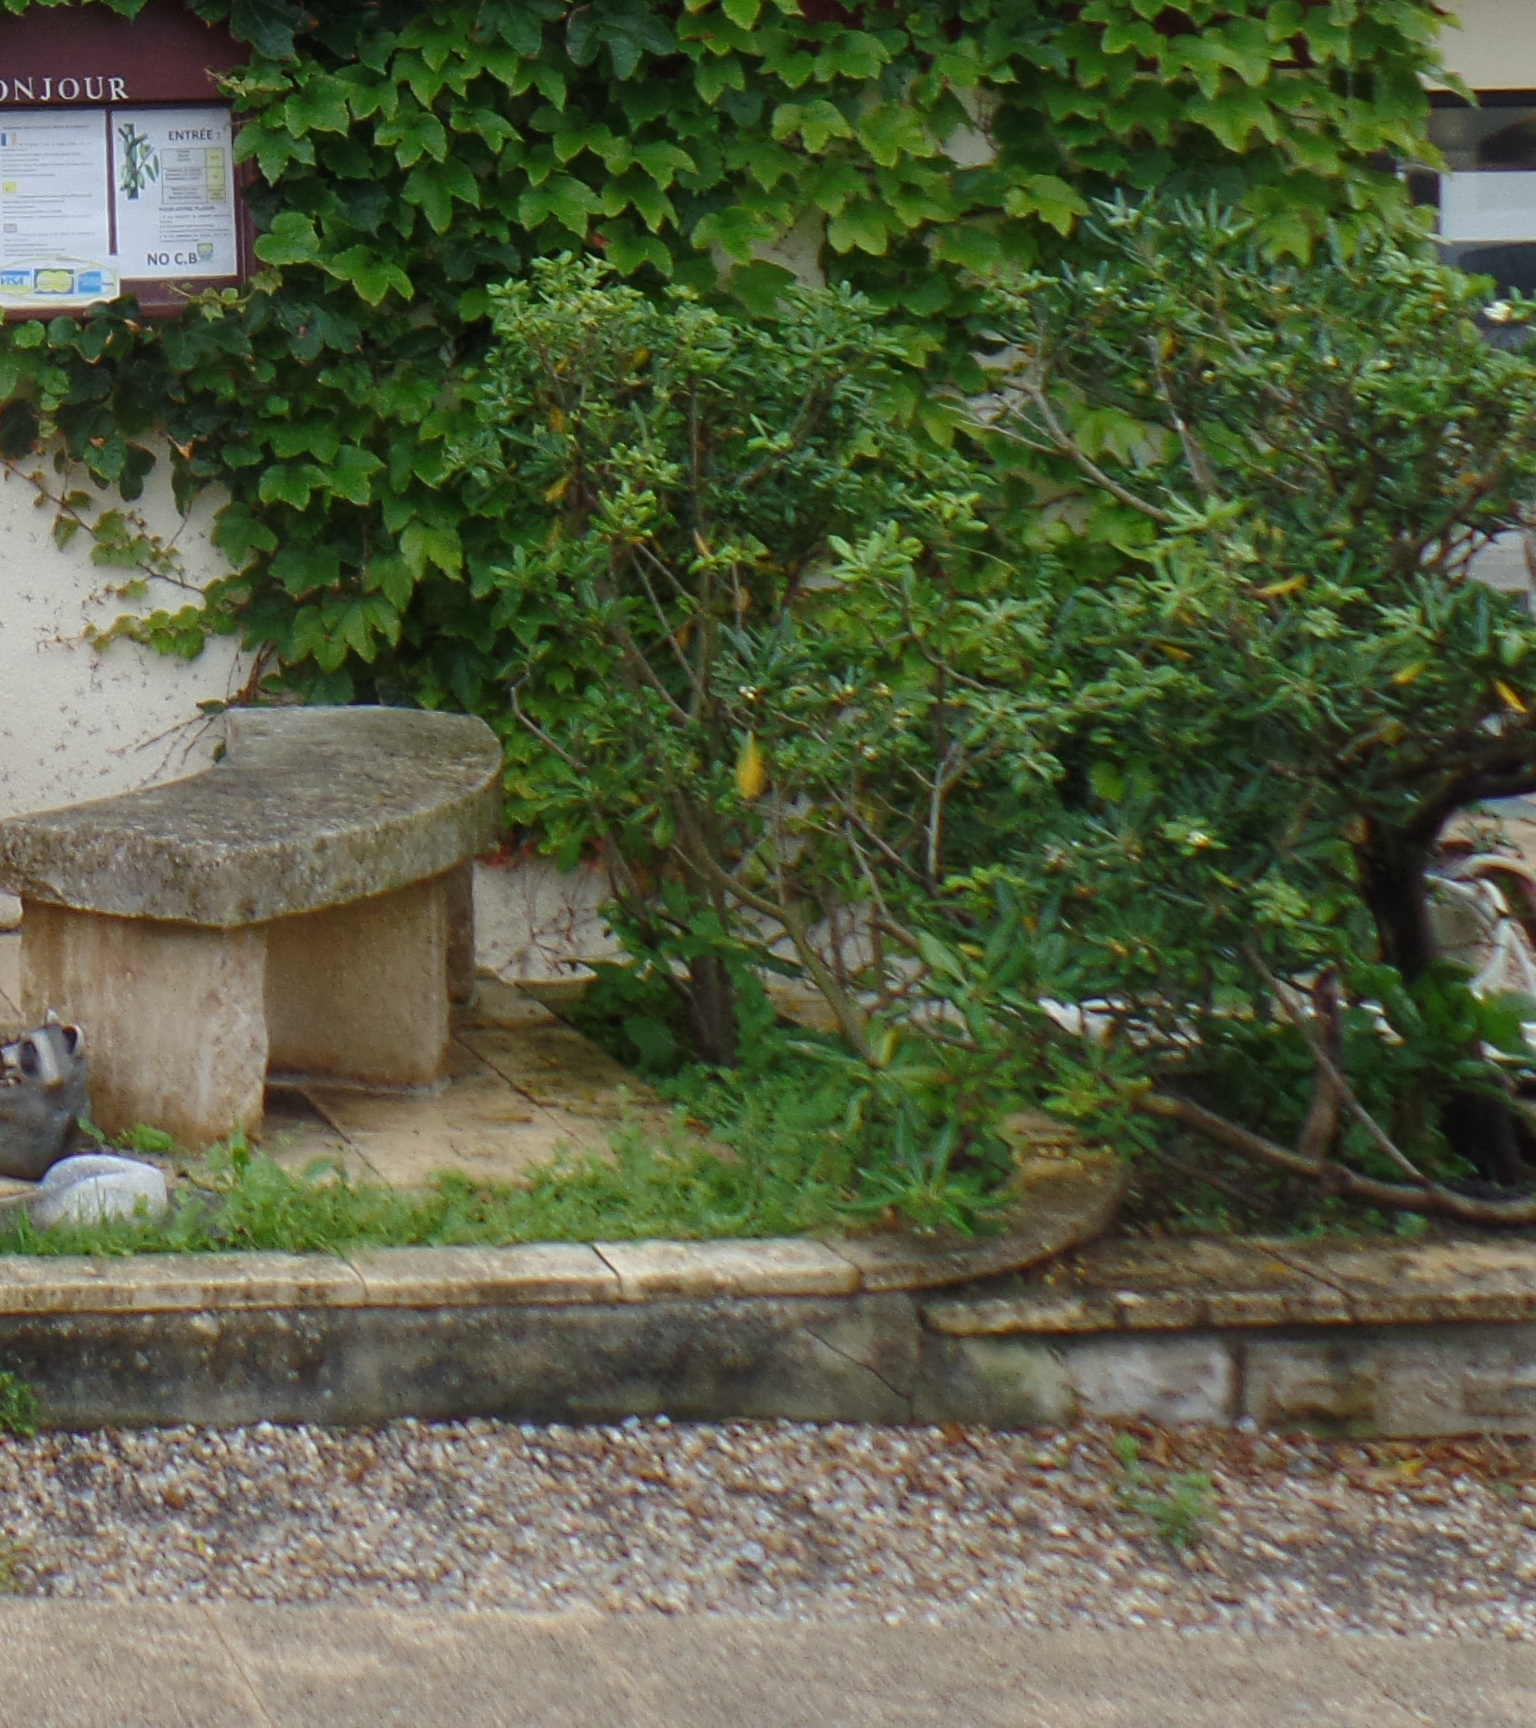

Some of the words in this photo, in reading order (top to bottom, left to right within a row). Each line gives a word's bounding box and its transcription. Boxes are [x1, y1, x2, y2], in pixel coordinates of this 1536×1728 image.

[168, 126, 213, 141] ENTRÉE
[147, 252, 170, 266] NO
[0, 276, 24, 286] VISA
